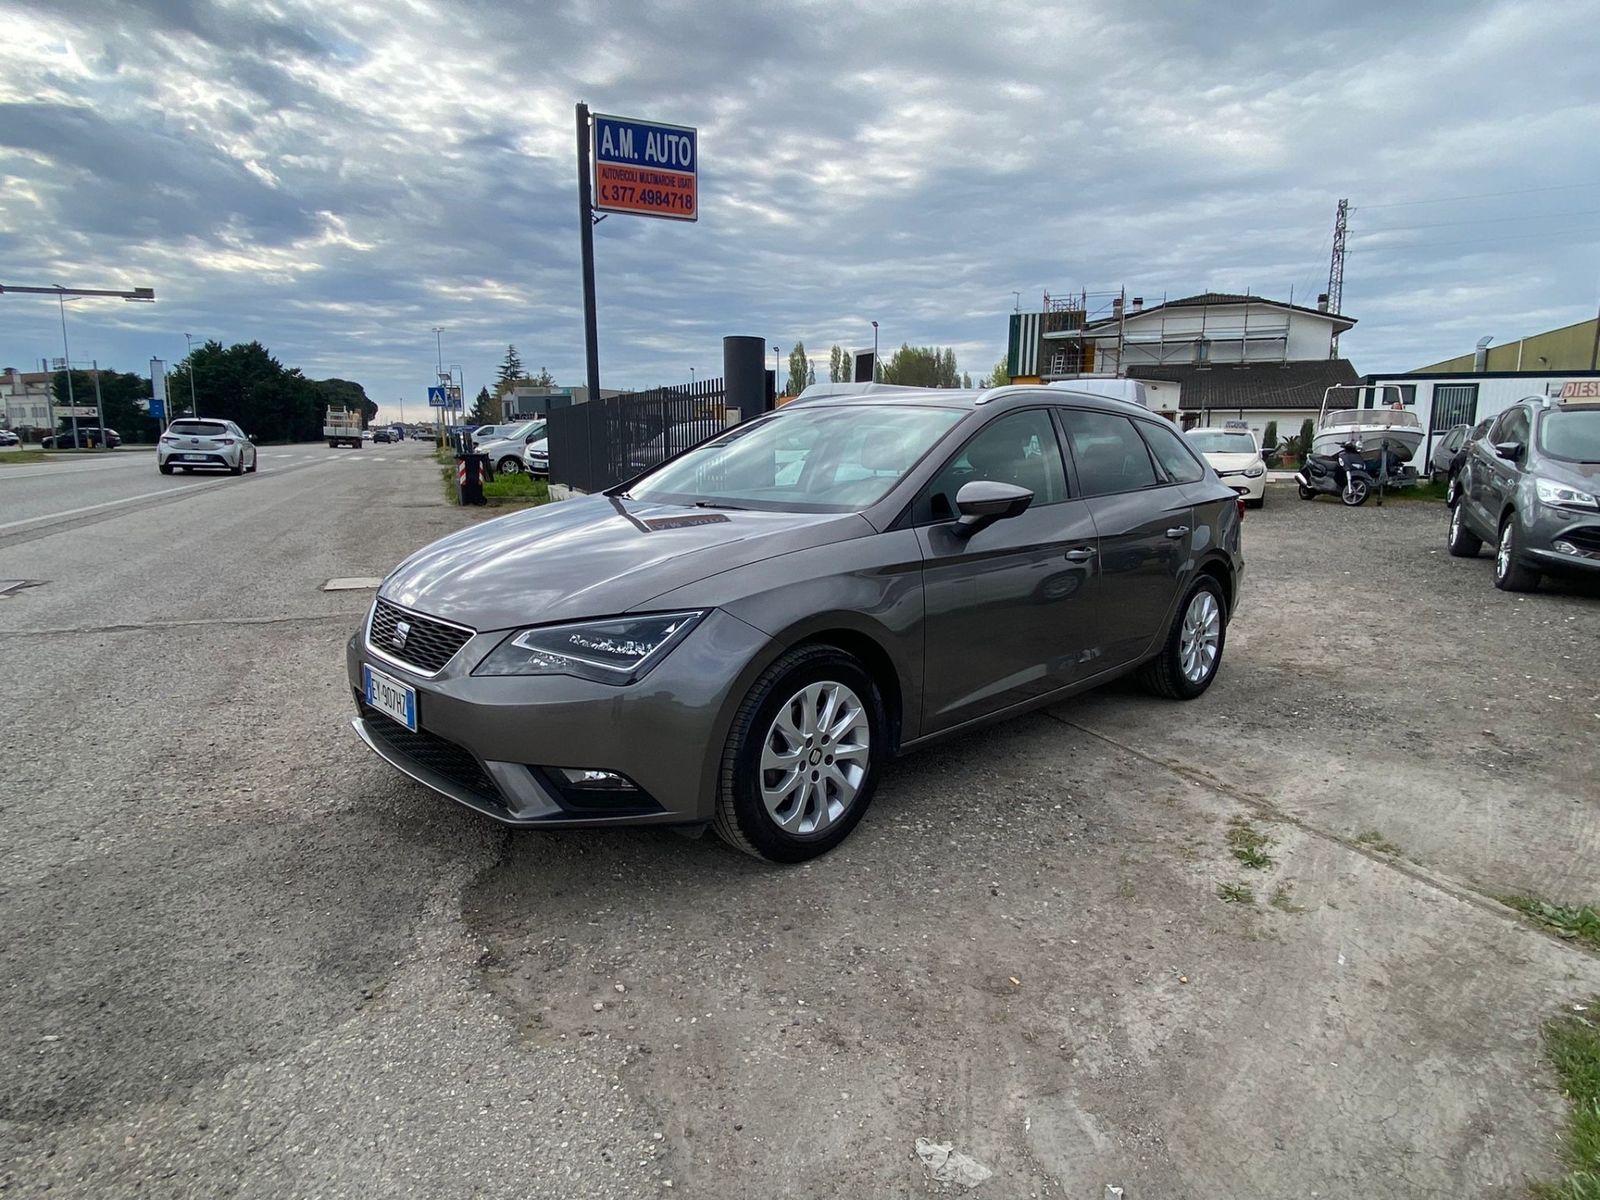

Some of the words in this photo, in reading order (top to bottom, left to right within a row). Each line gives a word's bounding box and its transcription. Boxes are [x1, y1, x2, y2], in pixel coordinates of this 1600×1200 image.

[601, 125, 638, 159] A.M.
[645, 131, 692, 166] AUTO
[602, 168, 638, 182] AUTOVEICOLI
[639, 173, 676, 188] MULTIMARCHE
[678, 177, 693, 189] USATI
[611, 185, 693, 209] 377.4984718
[1564, 382, 1600, 397] DIES
